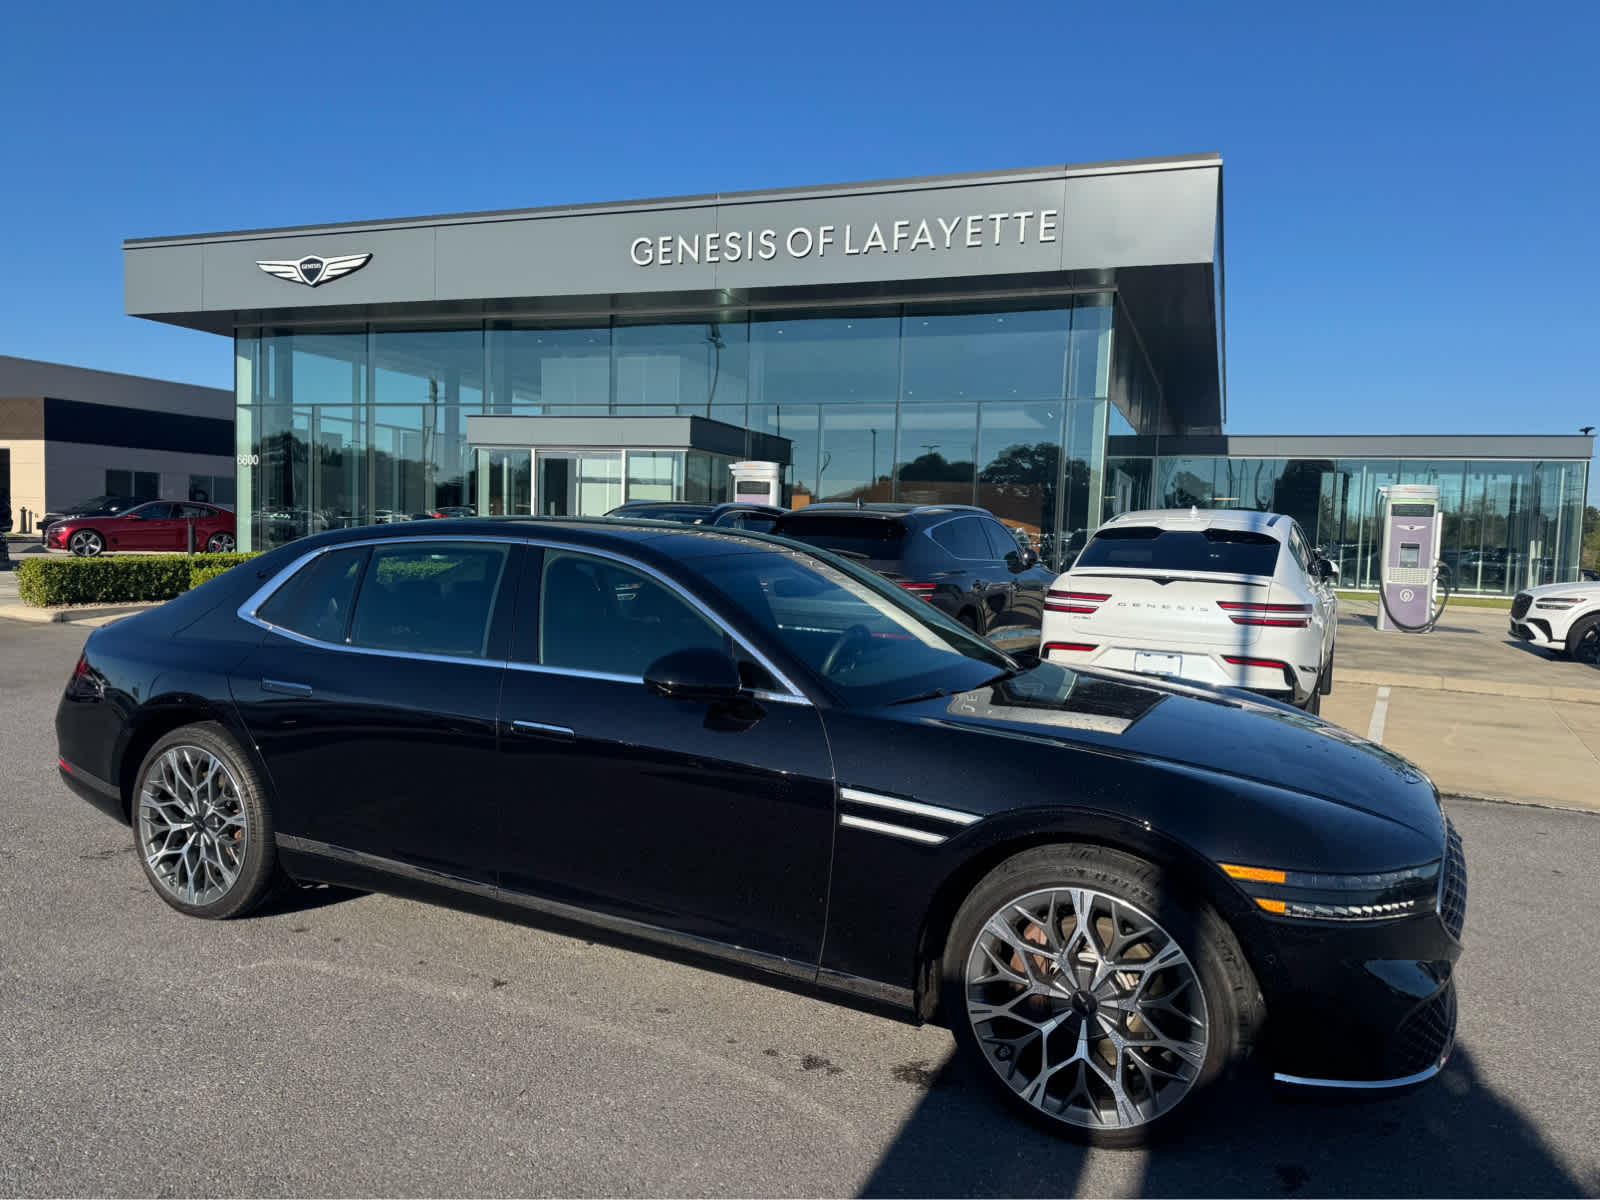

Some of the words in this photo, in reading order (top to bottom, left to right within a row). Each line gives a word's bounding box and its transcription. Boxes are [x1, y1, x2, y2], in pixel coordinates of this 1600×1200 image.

[630, 230, 777, 266] GENESIS
[786, 225, 835, 259] OF
[845, 209, 1058, 256] LAFAYETTE
